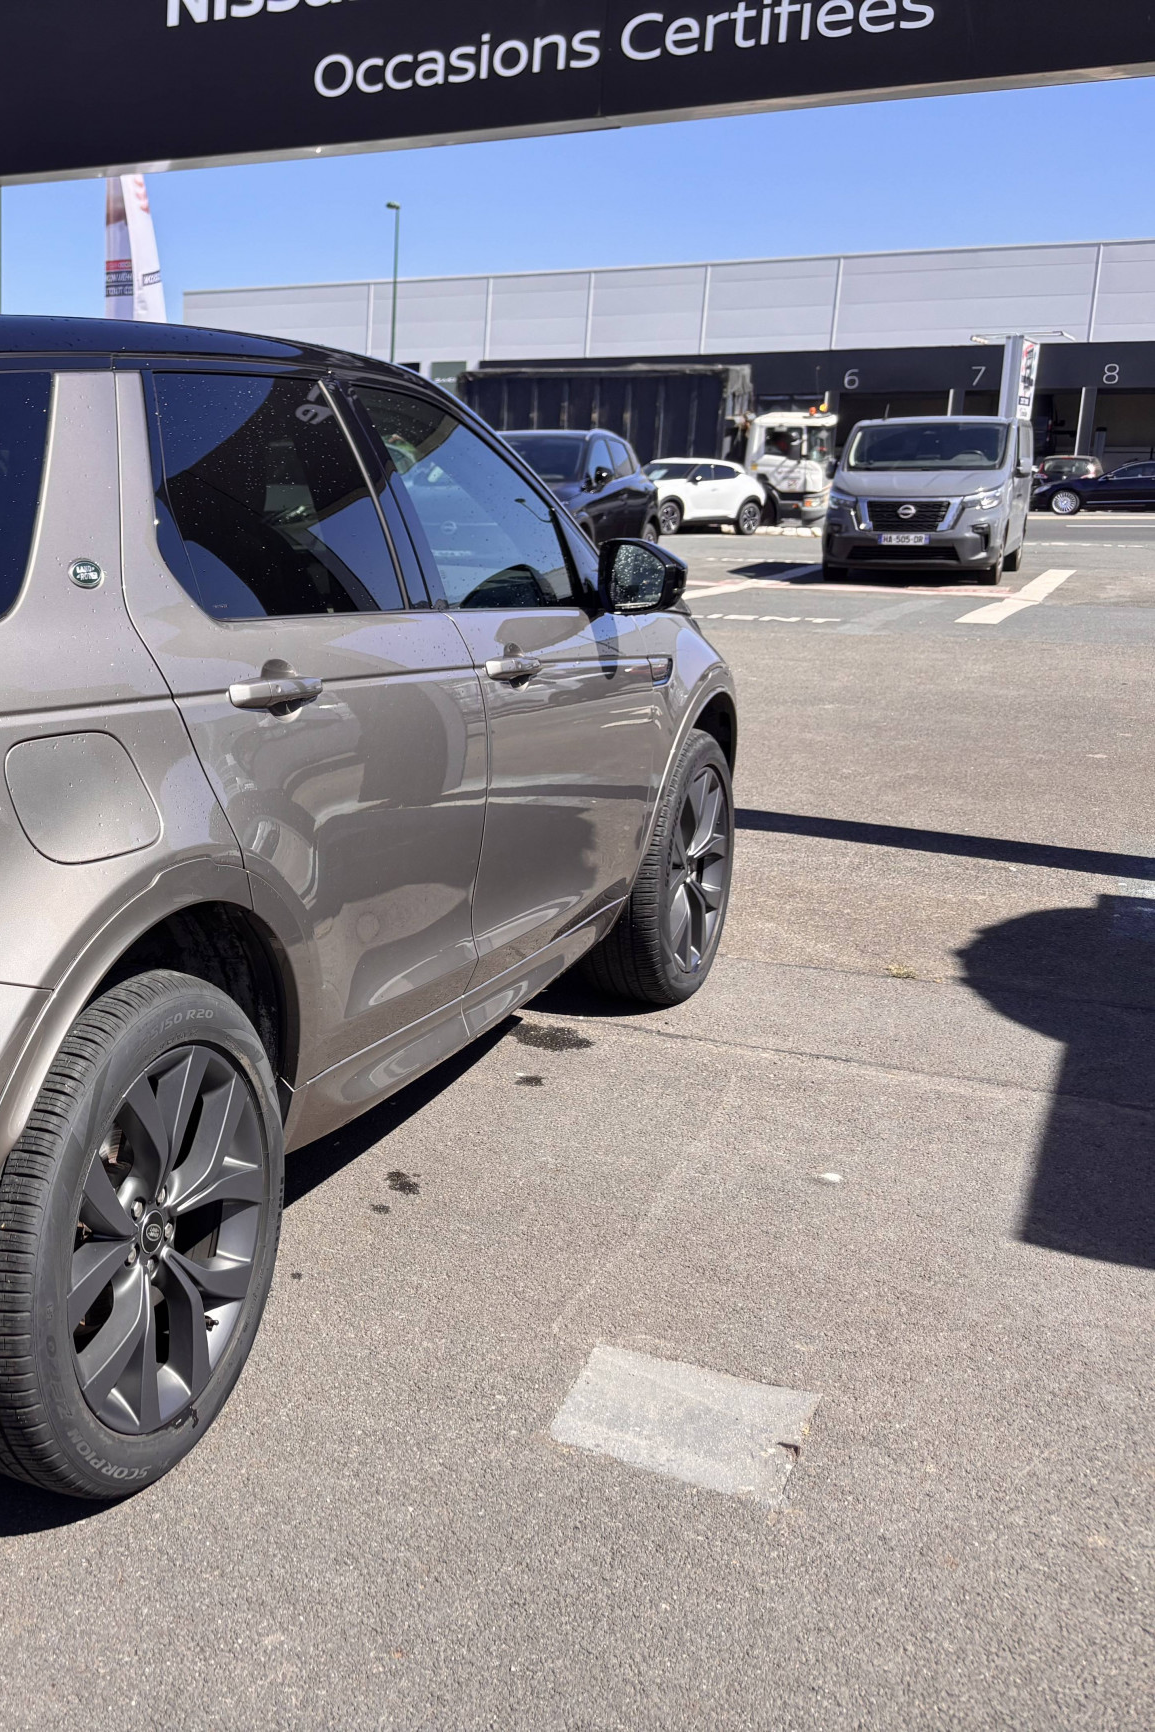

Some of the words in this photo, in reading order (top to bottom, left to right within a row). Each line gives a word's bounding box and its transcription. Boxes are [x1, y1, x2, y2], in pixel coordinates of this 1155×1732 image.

[314, 29, 601, 98] Occasions
[843, 368, 859, 390] 6
[971, 366, 986, 387] 7
[1103, 363, 1120, 385] 8
[186, 1008, 214, 1020] R20
[66, 1428, 153, 1481] SCORPION
